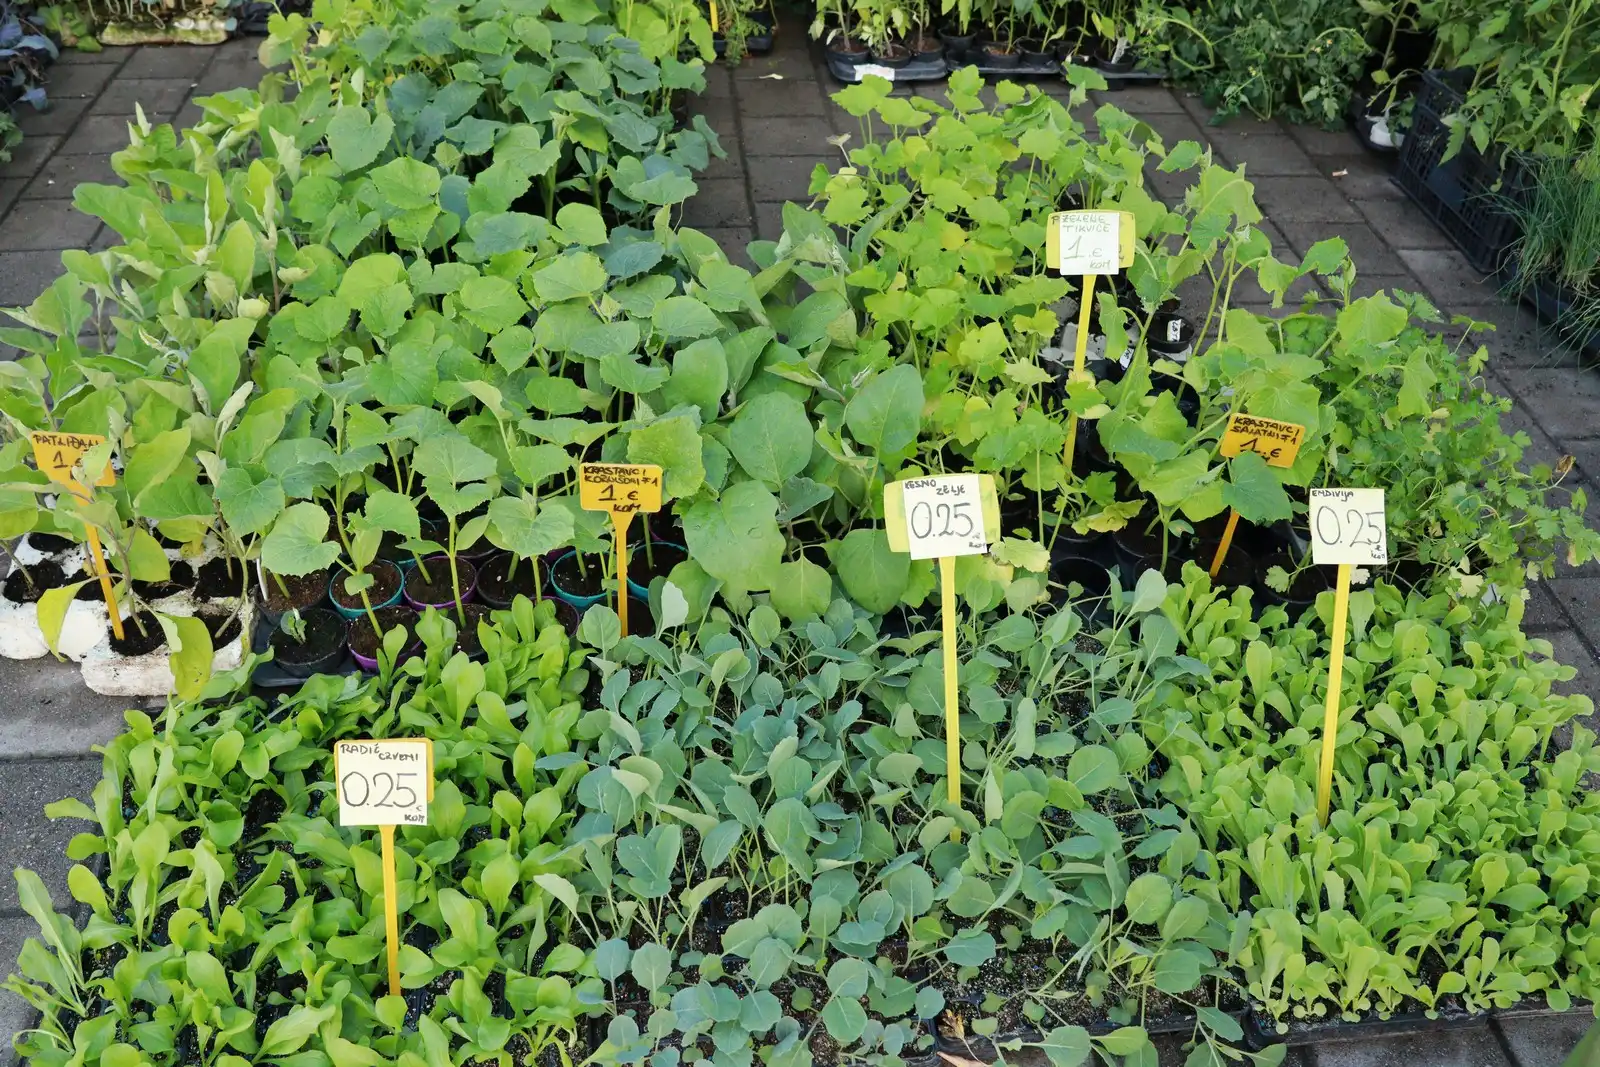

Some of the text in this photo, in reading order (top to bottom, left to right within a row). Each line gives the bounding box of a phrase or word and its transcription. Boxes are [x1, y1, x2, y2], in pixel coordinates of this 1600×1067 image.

[1062, 223, 1110, 233] TIKVICE
[1089, 259, 1111, 270] KOM
[583, 466, 646, 476] KRASTAVCI
[613, 503, 641, 512] KOM
[911, 501, 974, 539] 0.25
[1316, 505, 1385, 548] 0.25
[341, 771, 417, 808] 0.25
